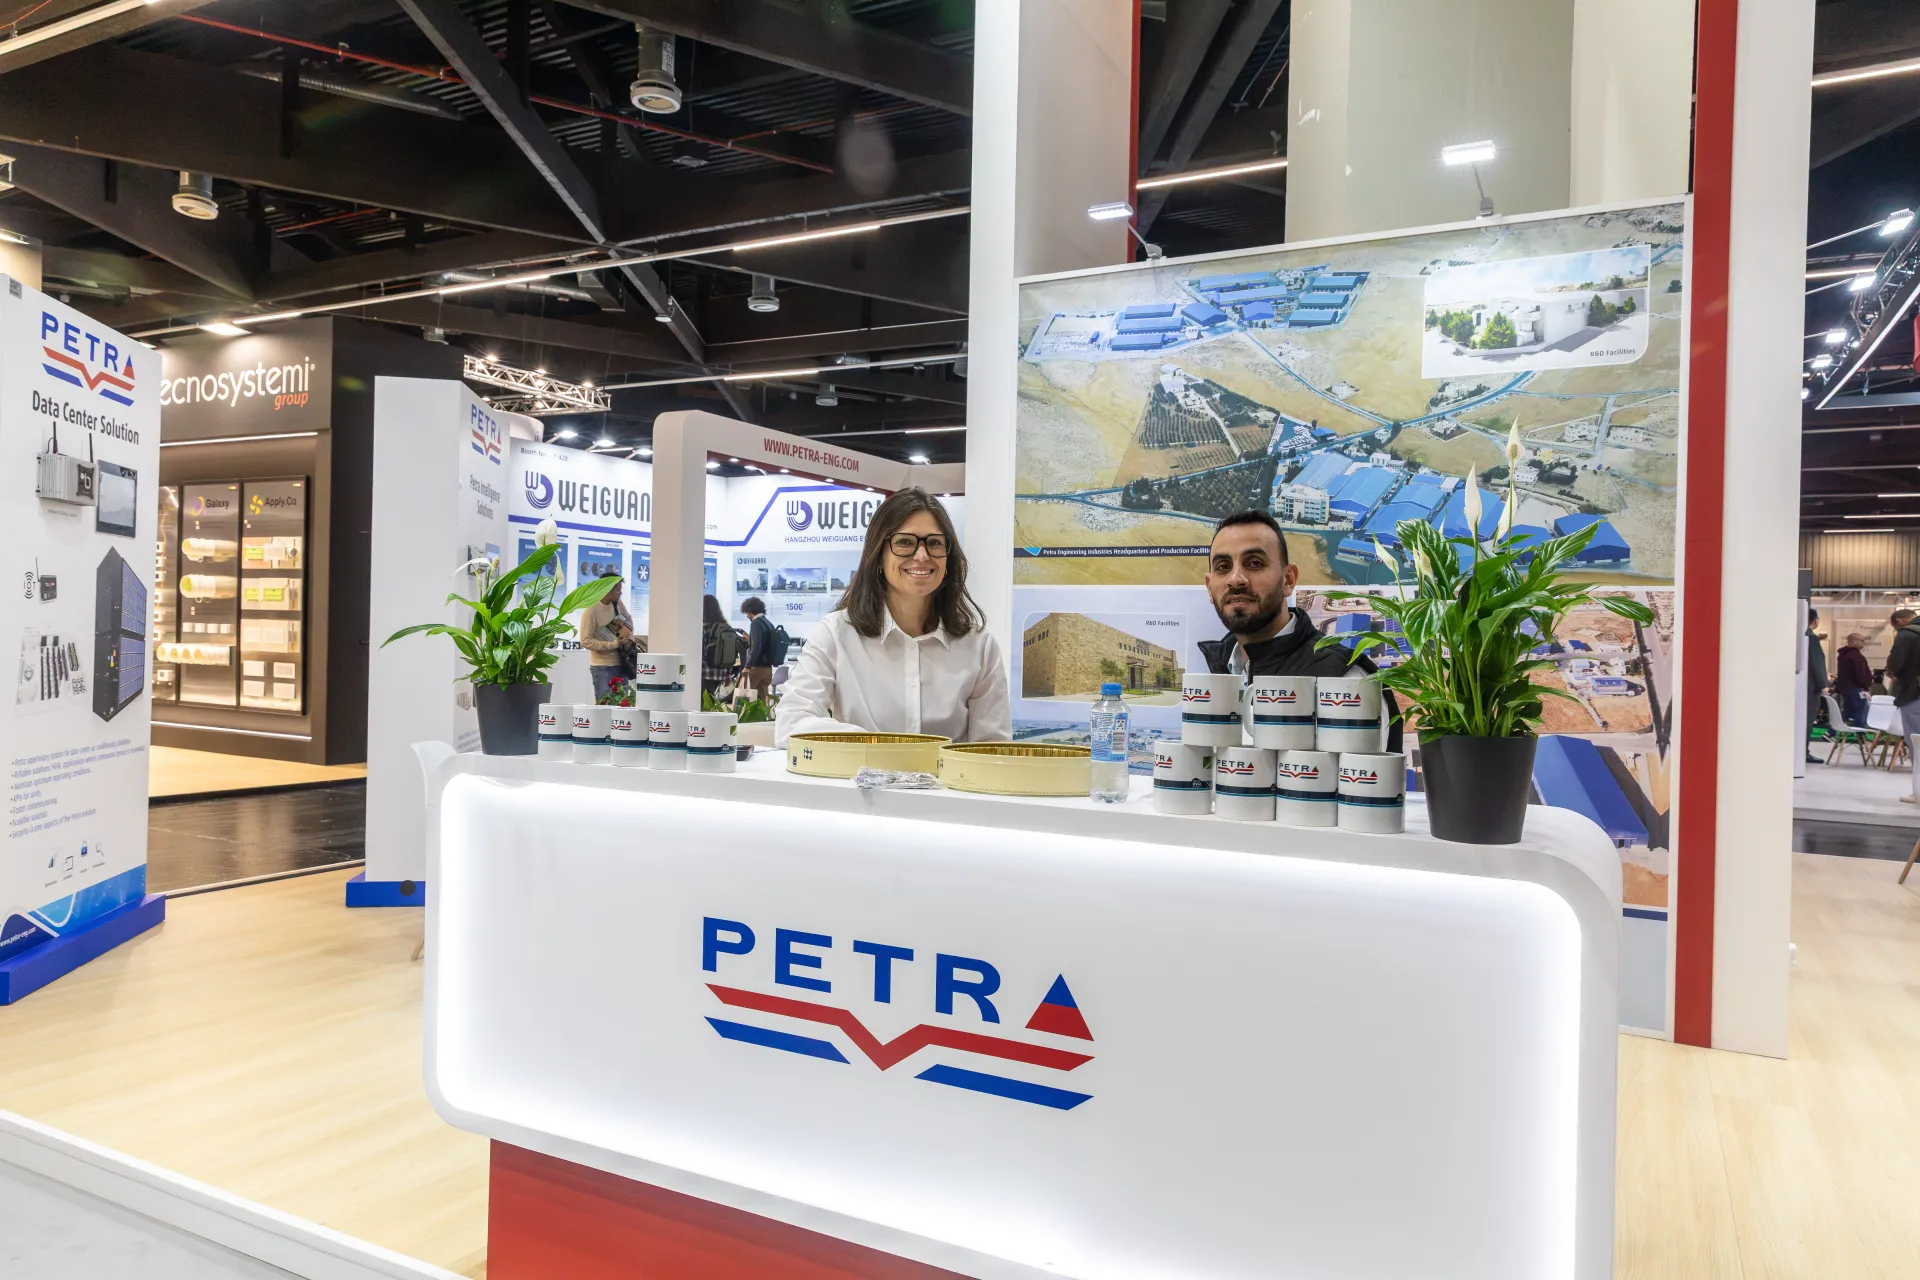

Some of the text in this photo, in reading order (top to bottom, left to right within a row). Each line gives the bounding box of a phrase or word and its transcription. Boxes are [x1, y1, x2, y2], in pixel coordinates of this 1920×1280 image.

[42, 311, 135, 380] PETRA
[1606, 348, 1636, 356] Facilities
[160, 356, 309, 408] ecnosystemi
[273, 392, 309, 411] group
[32, 390, 140, 446] Data Center Solution
[520, 447, 538, 456] Booth
[764, 437, 860, 473] WWW.PETRA-ENG.COM
[205, 499, 230, 510] Galaxy
[264, 496, 297, 508] Apply.Co
[558, 479, 651, 523] WEIGUAN
[784, 535, 821, 543] HANGZHOU
[822, 535, 858, 543] WEIGUANG
[1183, 688, 1211, 696] ETRA
[1255, 689, 1297, 697] PETRA
[1319, 692, 1362, 700] PETRA
[1279, 762, 1320, 773] PETRA
[702, 916, 1095, 1042] PETRA
